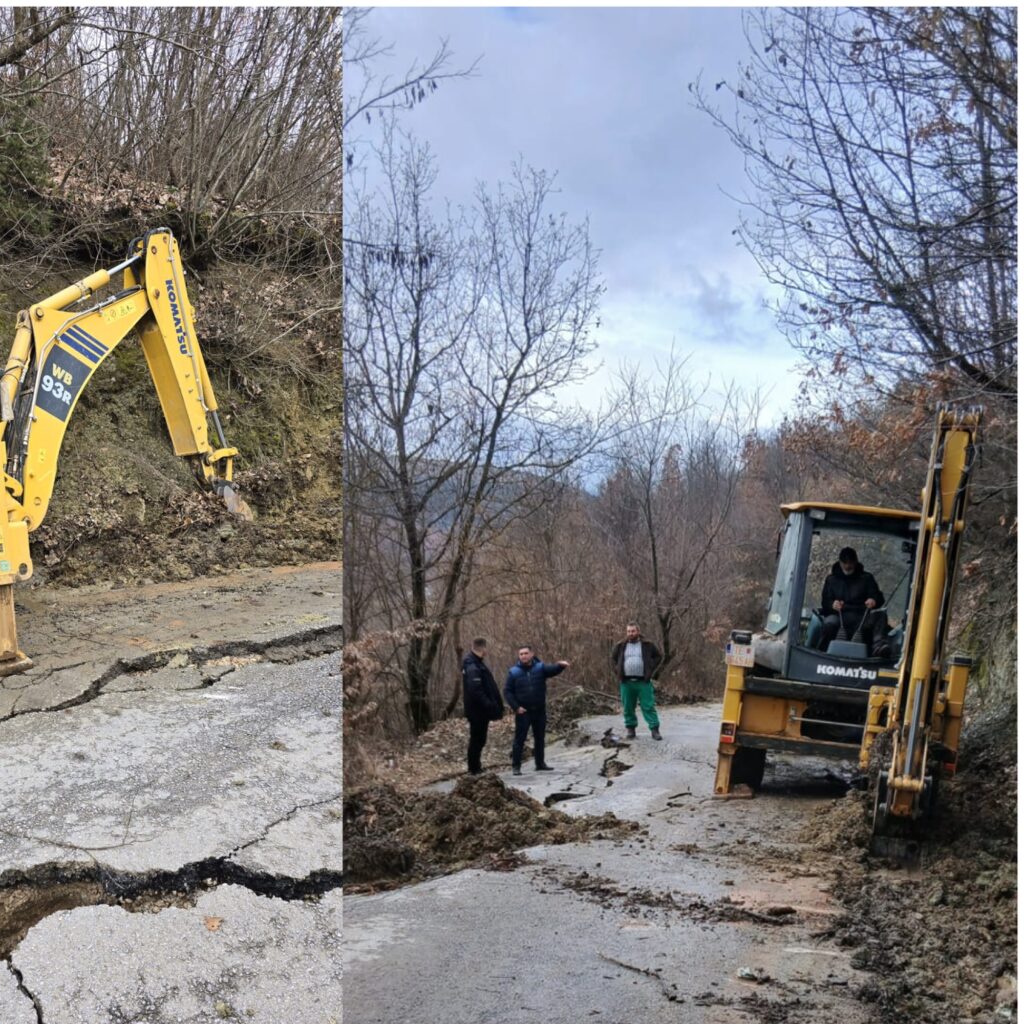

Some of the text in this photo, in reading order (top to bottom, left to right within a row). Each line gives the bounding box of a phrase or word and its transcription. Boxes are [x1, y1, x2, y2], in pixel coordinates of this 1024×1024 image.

[165, 279, 188, 354] KOMATSU
[52, 362, 73, 386] WB
[41, 374, 72, 405] 93R
[816, 664, 877, 680] KOMATSU
